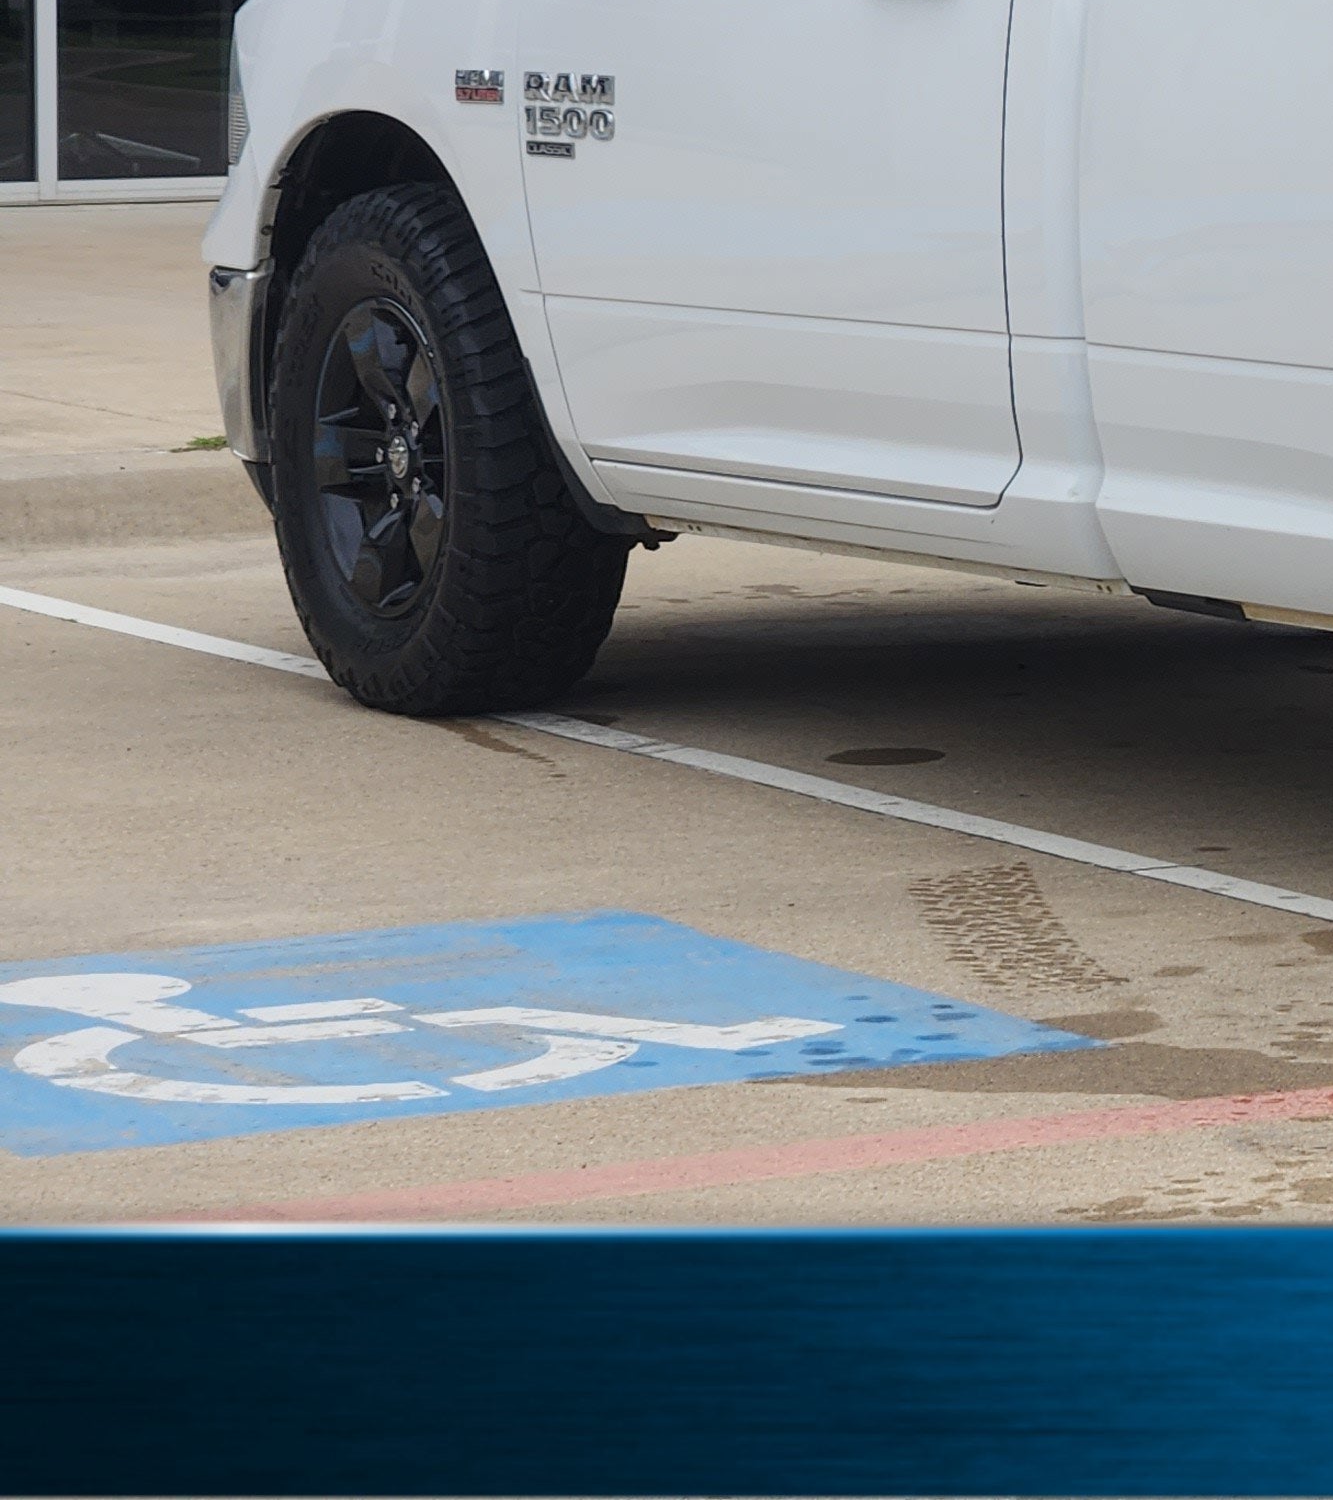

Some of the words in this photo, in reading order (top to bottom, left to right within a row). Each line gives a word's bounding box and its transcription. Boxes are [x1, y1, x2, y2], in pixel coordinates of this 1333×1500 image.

[524, 71, 615, 105] RAM
[525, 106, 615, 141] 1500
[527, 142, 573, 157] CLASSIC
